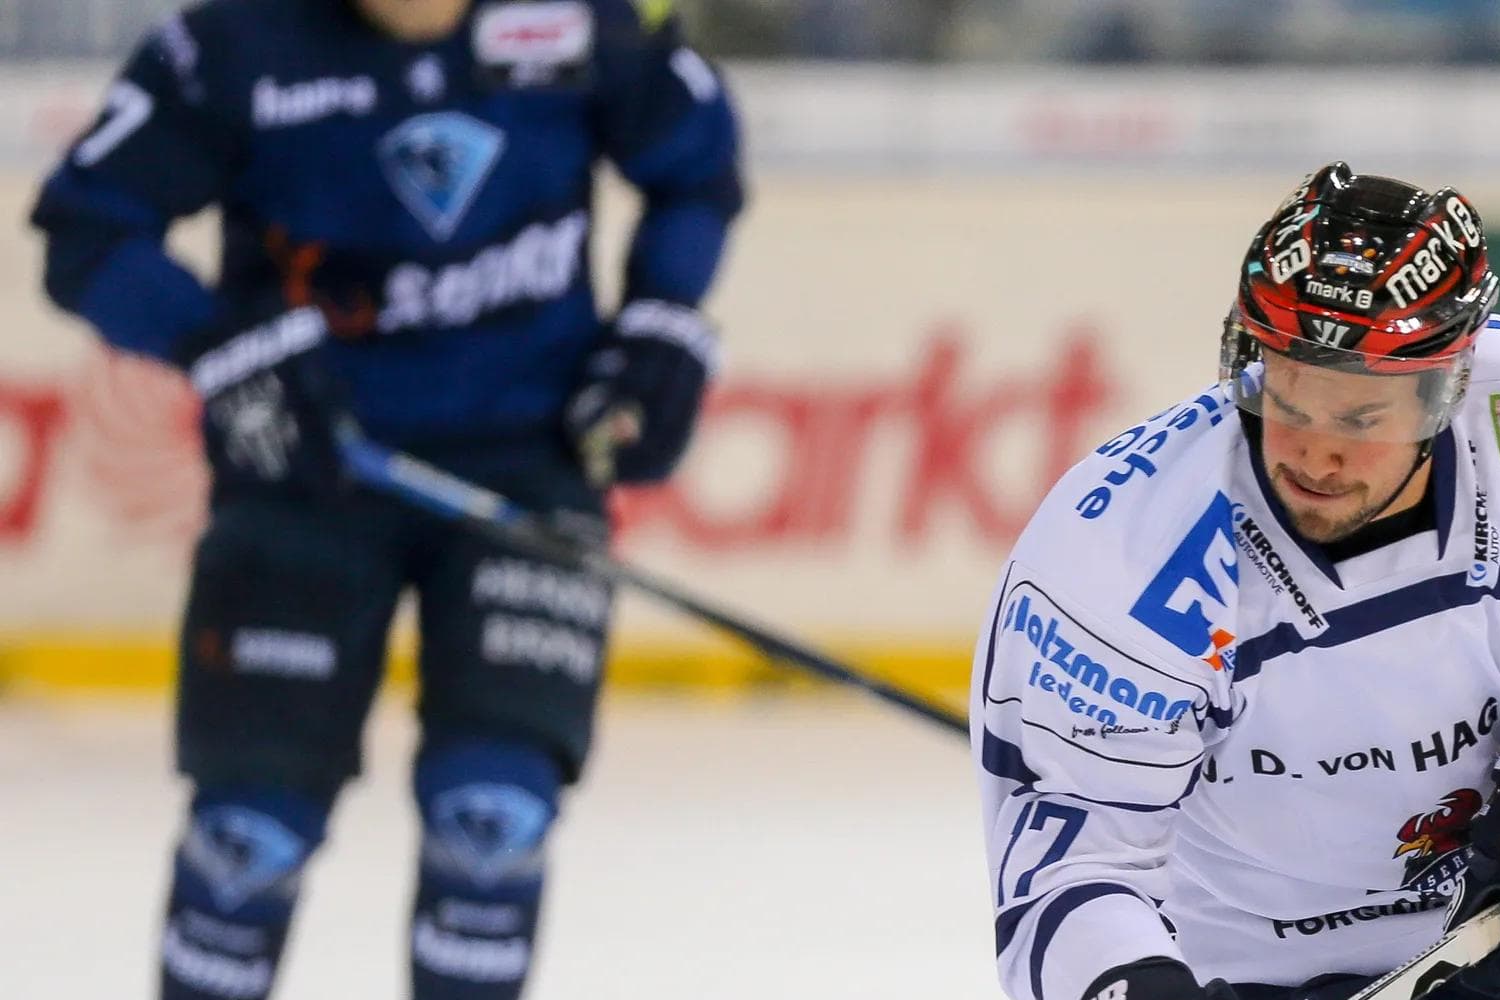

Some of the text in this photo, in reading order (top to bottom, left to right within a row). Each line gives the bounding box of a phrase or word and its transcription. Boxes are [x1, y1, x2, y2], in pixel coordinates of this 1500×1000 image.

[1306, 280, 1352, 303] mark
[1233, 531, 1286, 596] AUTOMOTIVE
[1240, 517, 1324, 629] KIRCHHOFF
[1028, 661, 1117, 727] federn
[1250, 749, 1304, 779] D.
